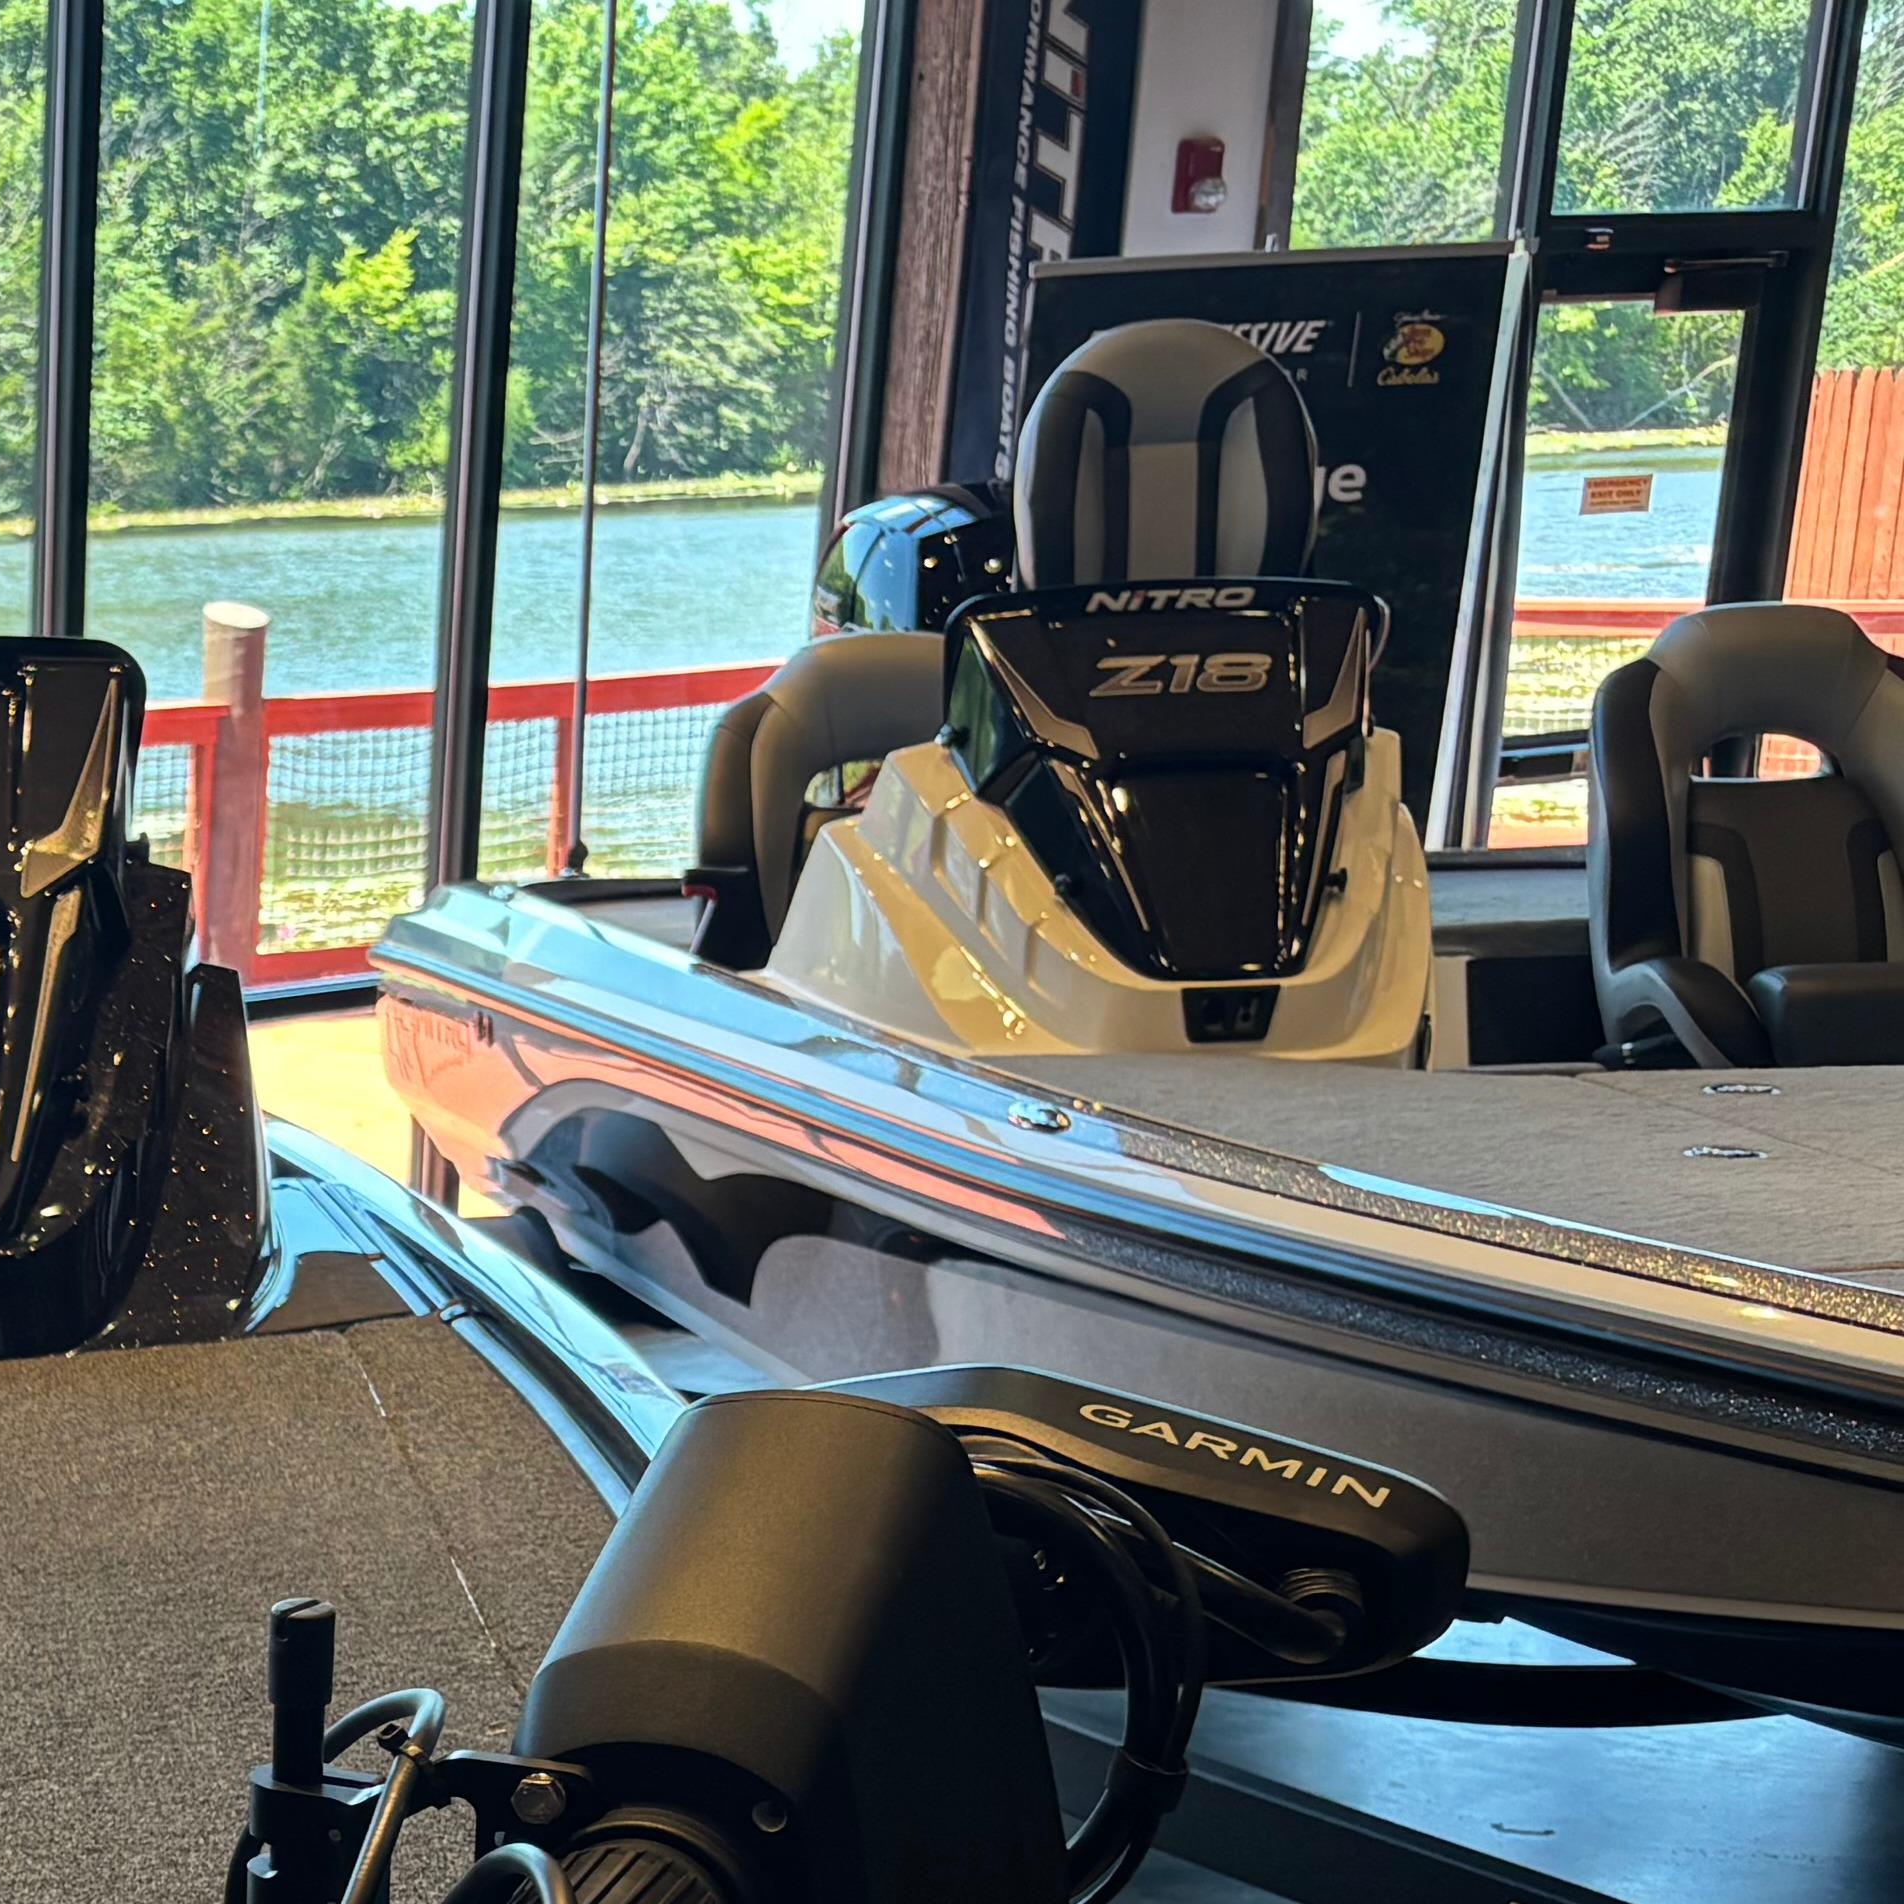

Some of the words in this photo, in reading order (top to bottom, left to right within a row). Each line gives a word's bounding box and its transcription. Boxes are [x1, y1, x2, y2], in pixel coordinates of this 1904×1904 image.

[1004, 194, 1026, 347] FISHING
[995, 355, 1017, 482] BOATS
[1085, 586, 1257, 613] NITRO
[1088, 652, 1273, 697] Z18
[1079, 1404, 1390, 1509] GARMIN
